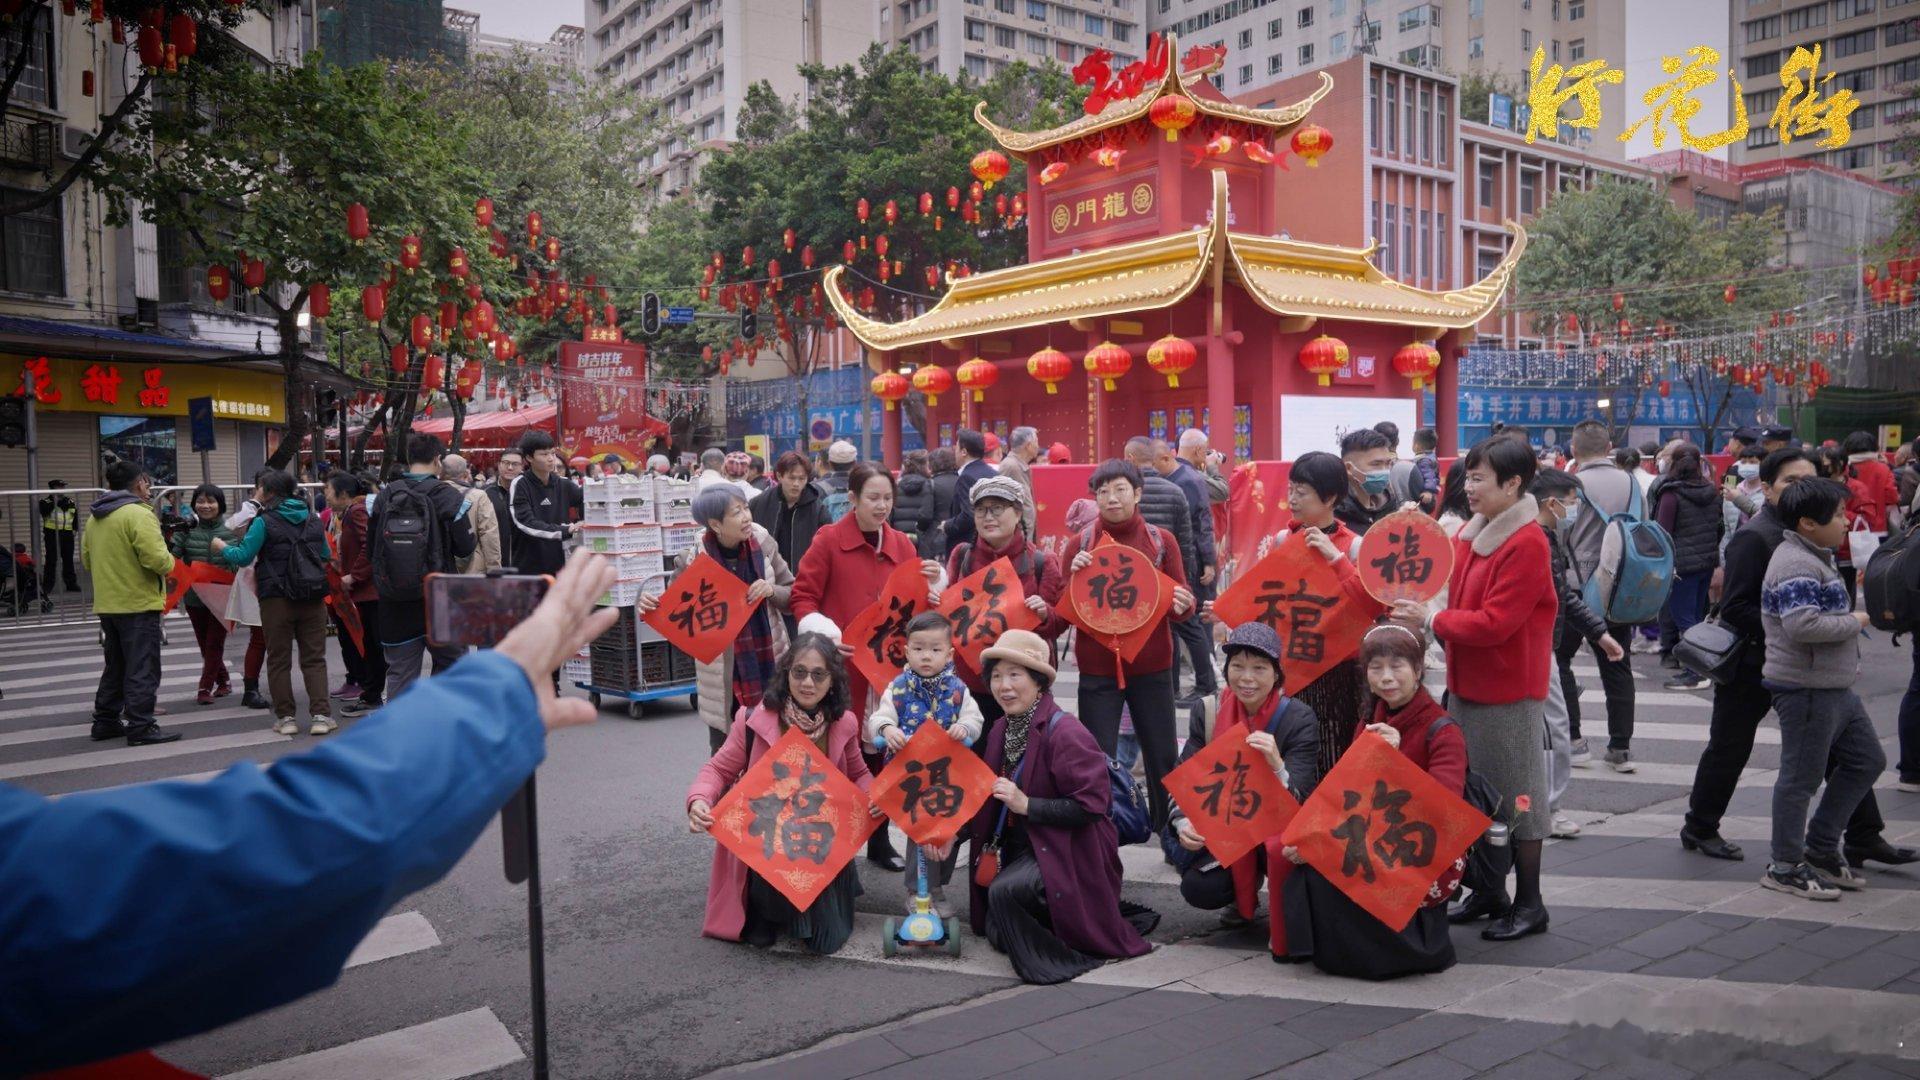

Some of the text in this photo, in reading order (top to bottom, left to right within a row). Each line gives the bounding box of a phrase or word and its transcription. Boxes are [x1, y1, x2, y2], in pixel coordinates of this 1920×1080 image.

[590, 330, 617, 340] 王老吉
[14, 357, 170, 407] 花甜品
[1088, 554, 1137, 611] 福
[1371, 527, 1433, 585] 福
[668, 578, 729, 638] 福
[949, 567, 1008, 646] 福
[1254, 578, 1339, 664] 福
[749, 753, 836, 865] 福
[900, 757, 965, 824] 福
[1193, 751, 1262, 825] 福
[1331, 780, 1437, 884] 福
